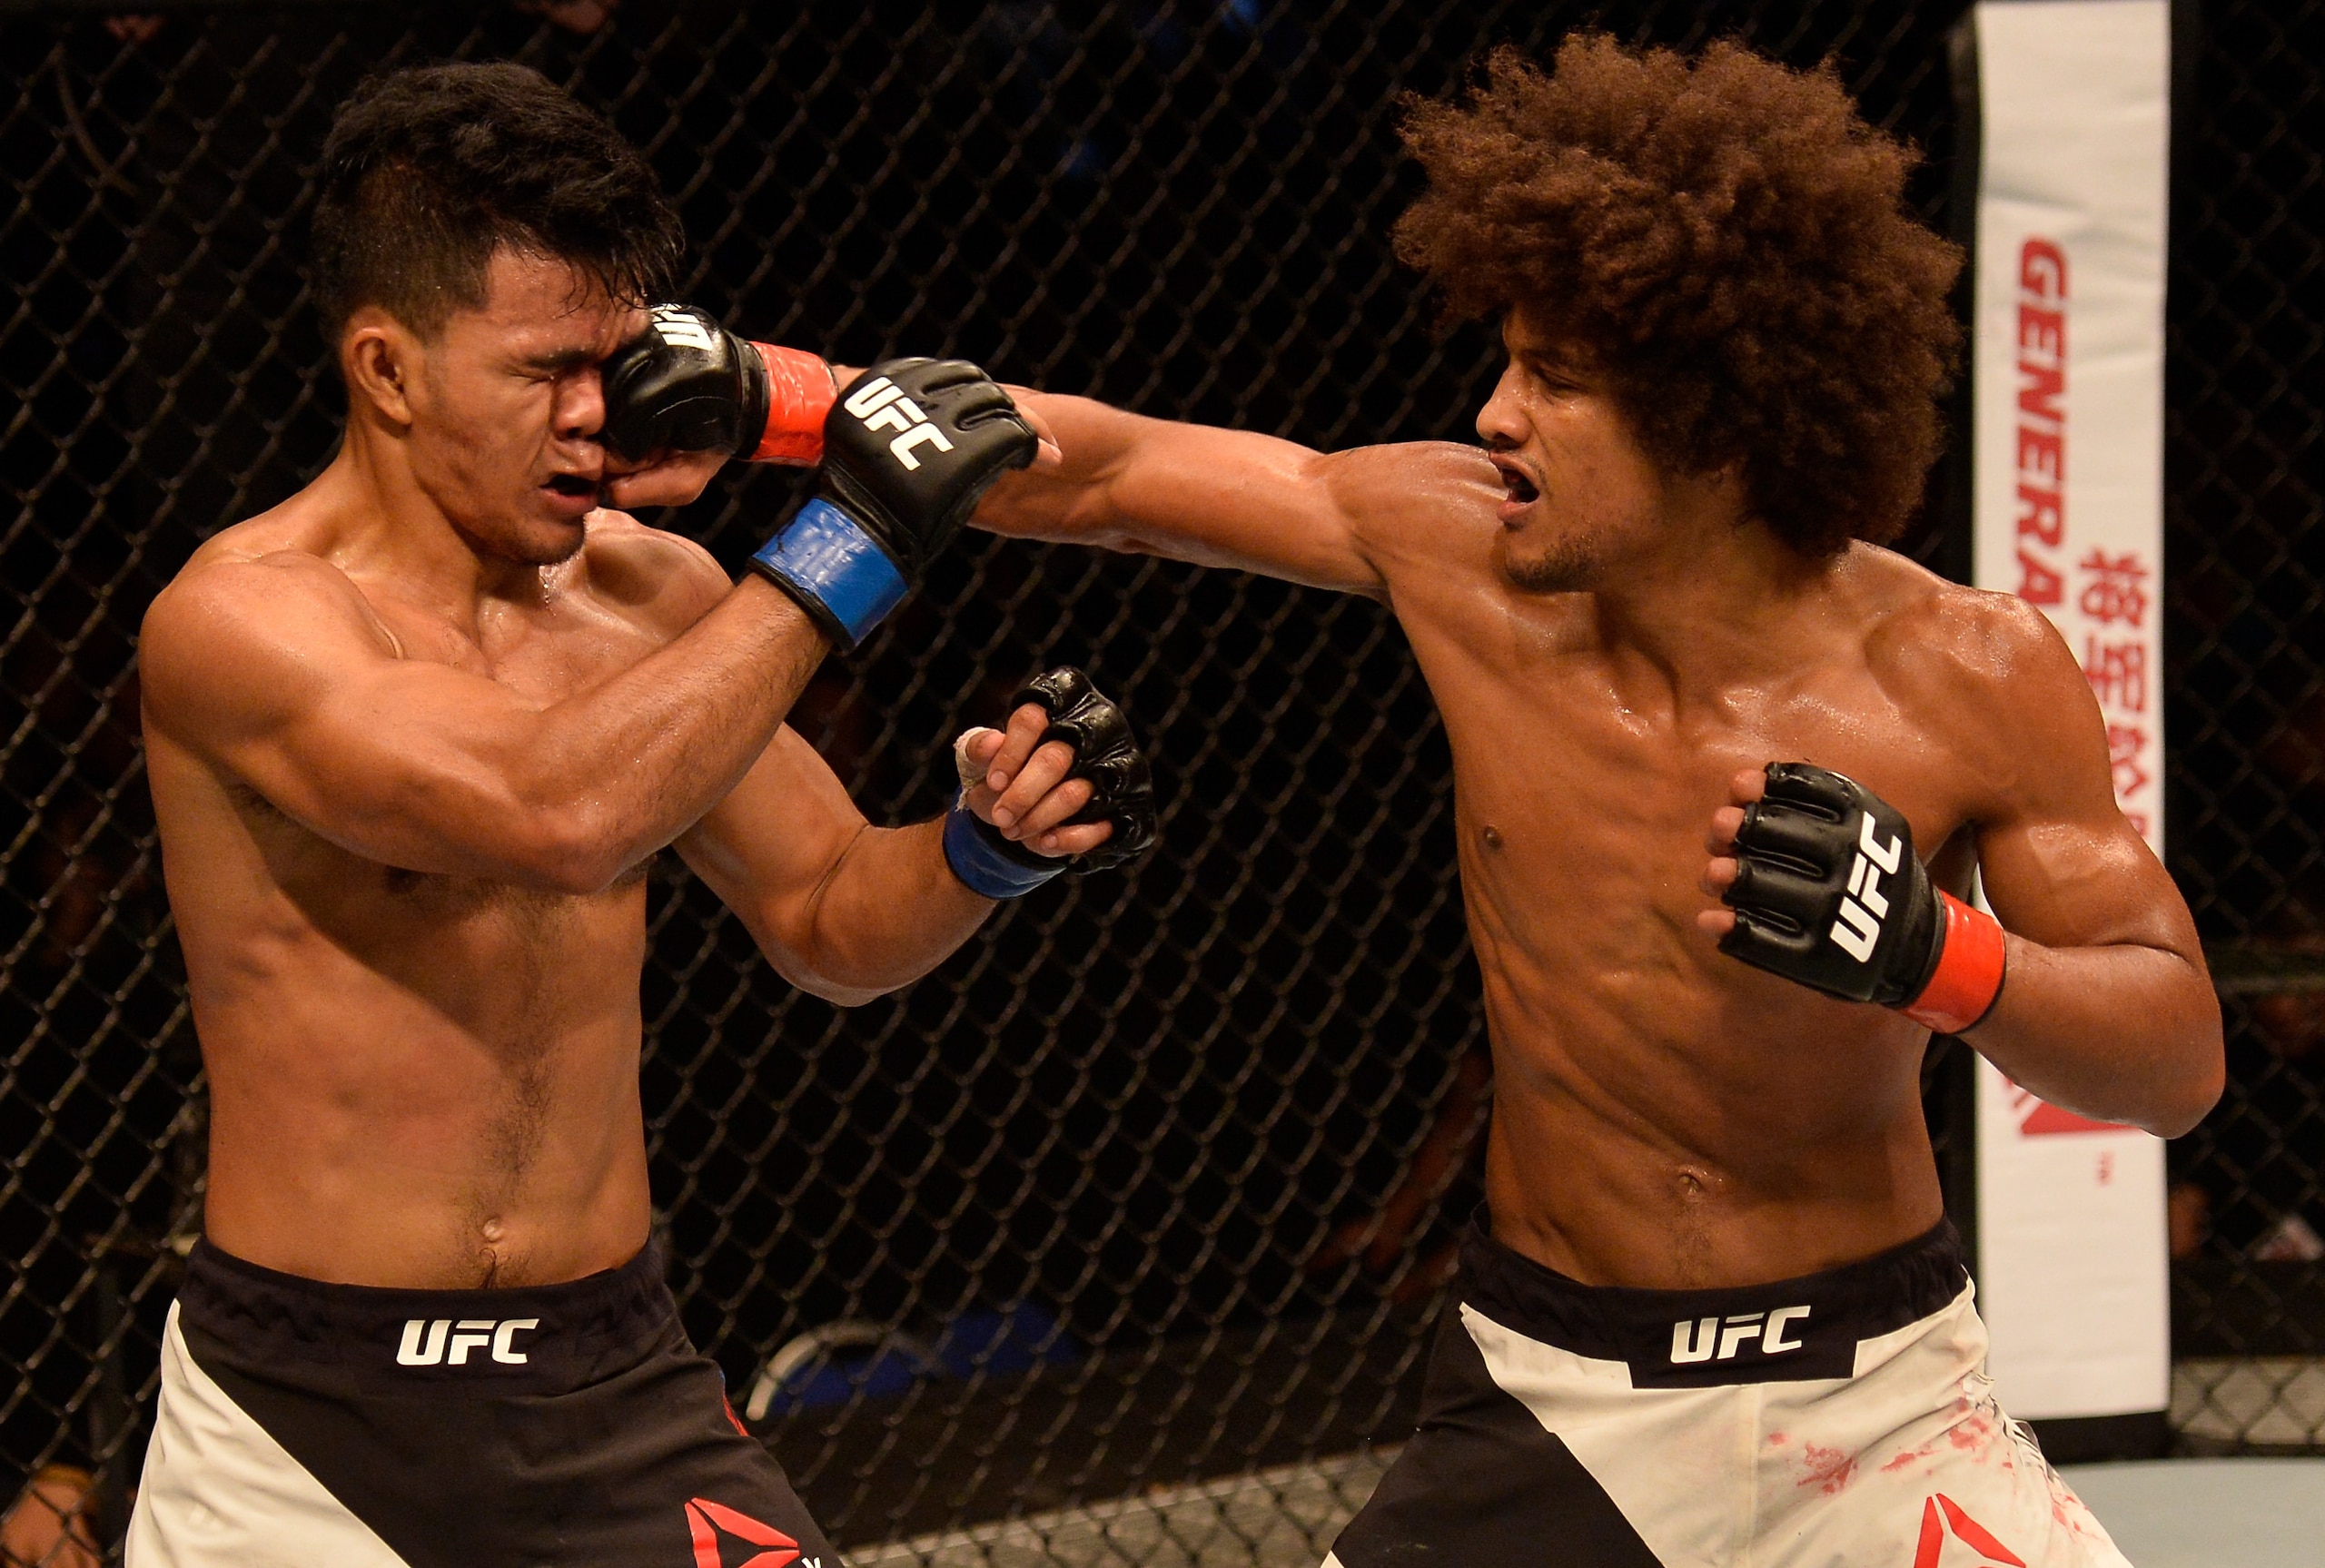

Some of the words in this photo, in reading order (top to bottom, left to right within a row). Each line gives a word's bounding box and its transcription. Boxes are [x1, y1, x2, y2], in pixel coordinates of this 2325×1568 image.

[845, 377, 955, 471] UFC
[2016, 236, 2067, 606] GENERA
[1830, 811, 1903, 962] UFC
[396, 1318, 539, 1366] UFC
[1670, 1305, 1811, 1364] UFC
